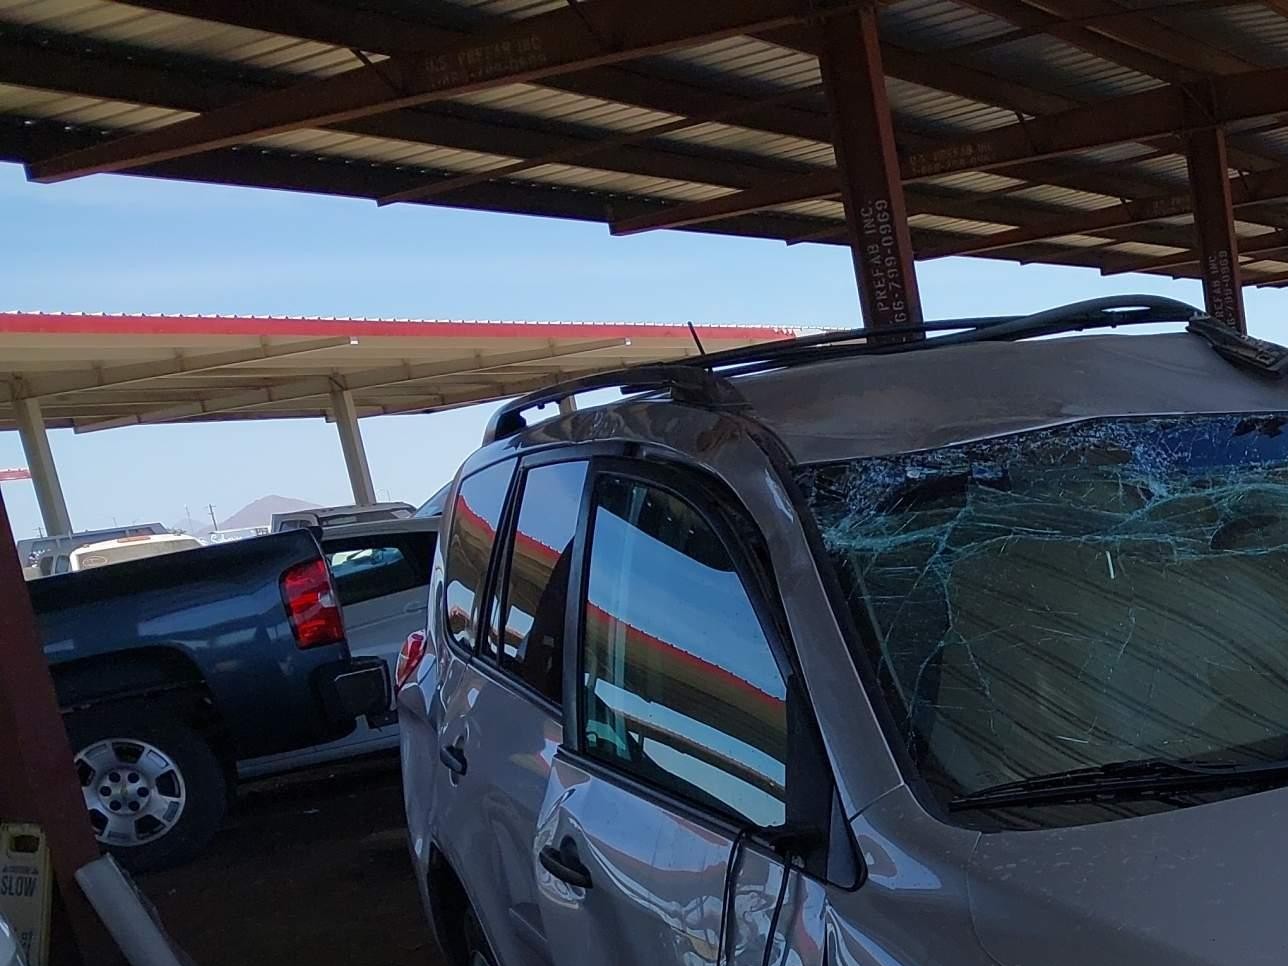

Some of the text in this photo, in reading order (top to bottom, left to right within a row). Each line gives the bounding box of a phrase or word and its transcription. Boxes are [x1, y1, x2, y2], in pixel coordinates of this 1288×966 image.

[867, 244, 889, 311] PREFAB
[875, 200, 907, 322] 66-799-0969
[1, 875, 37, 897] SLOW
